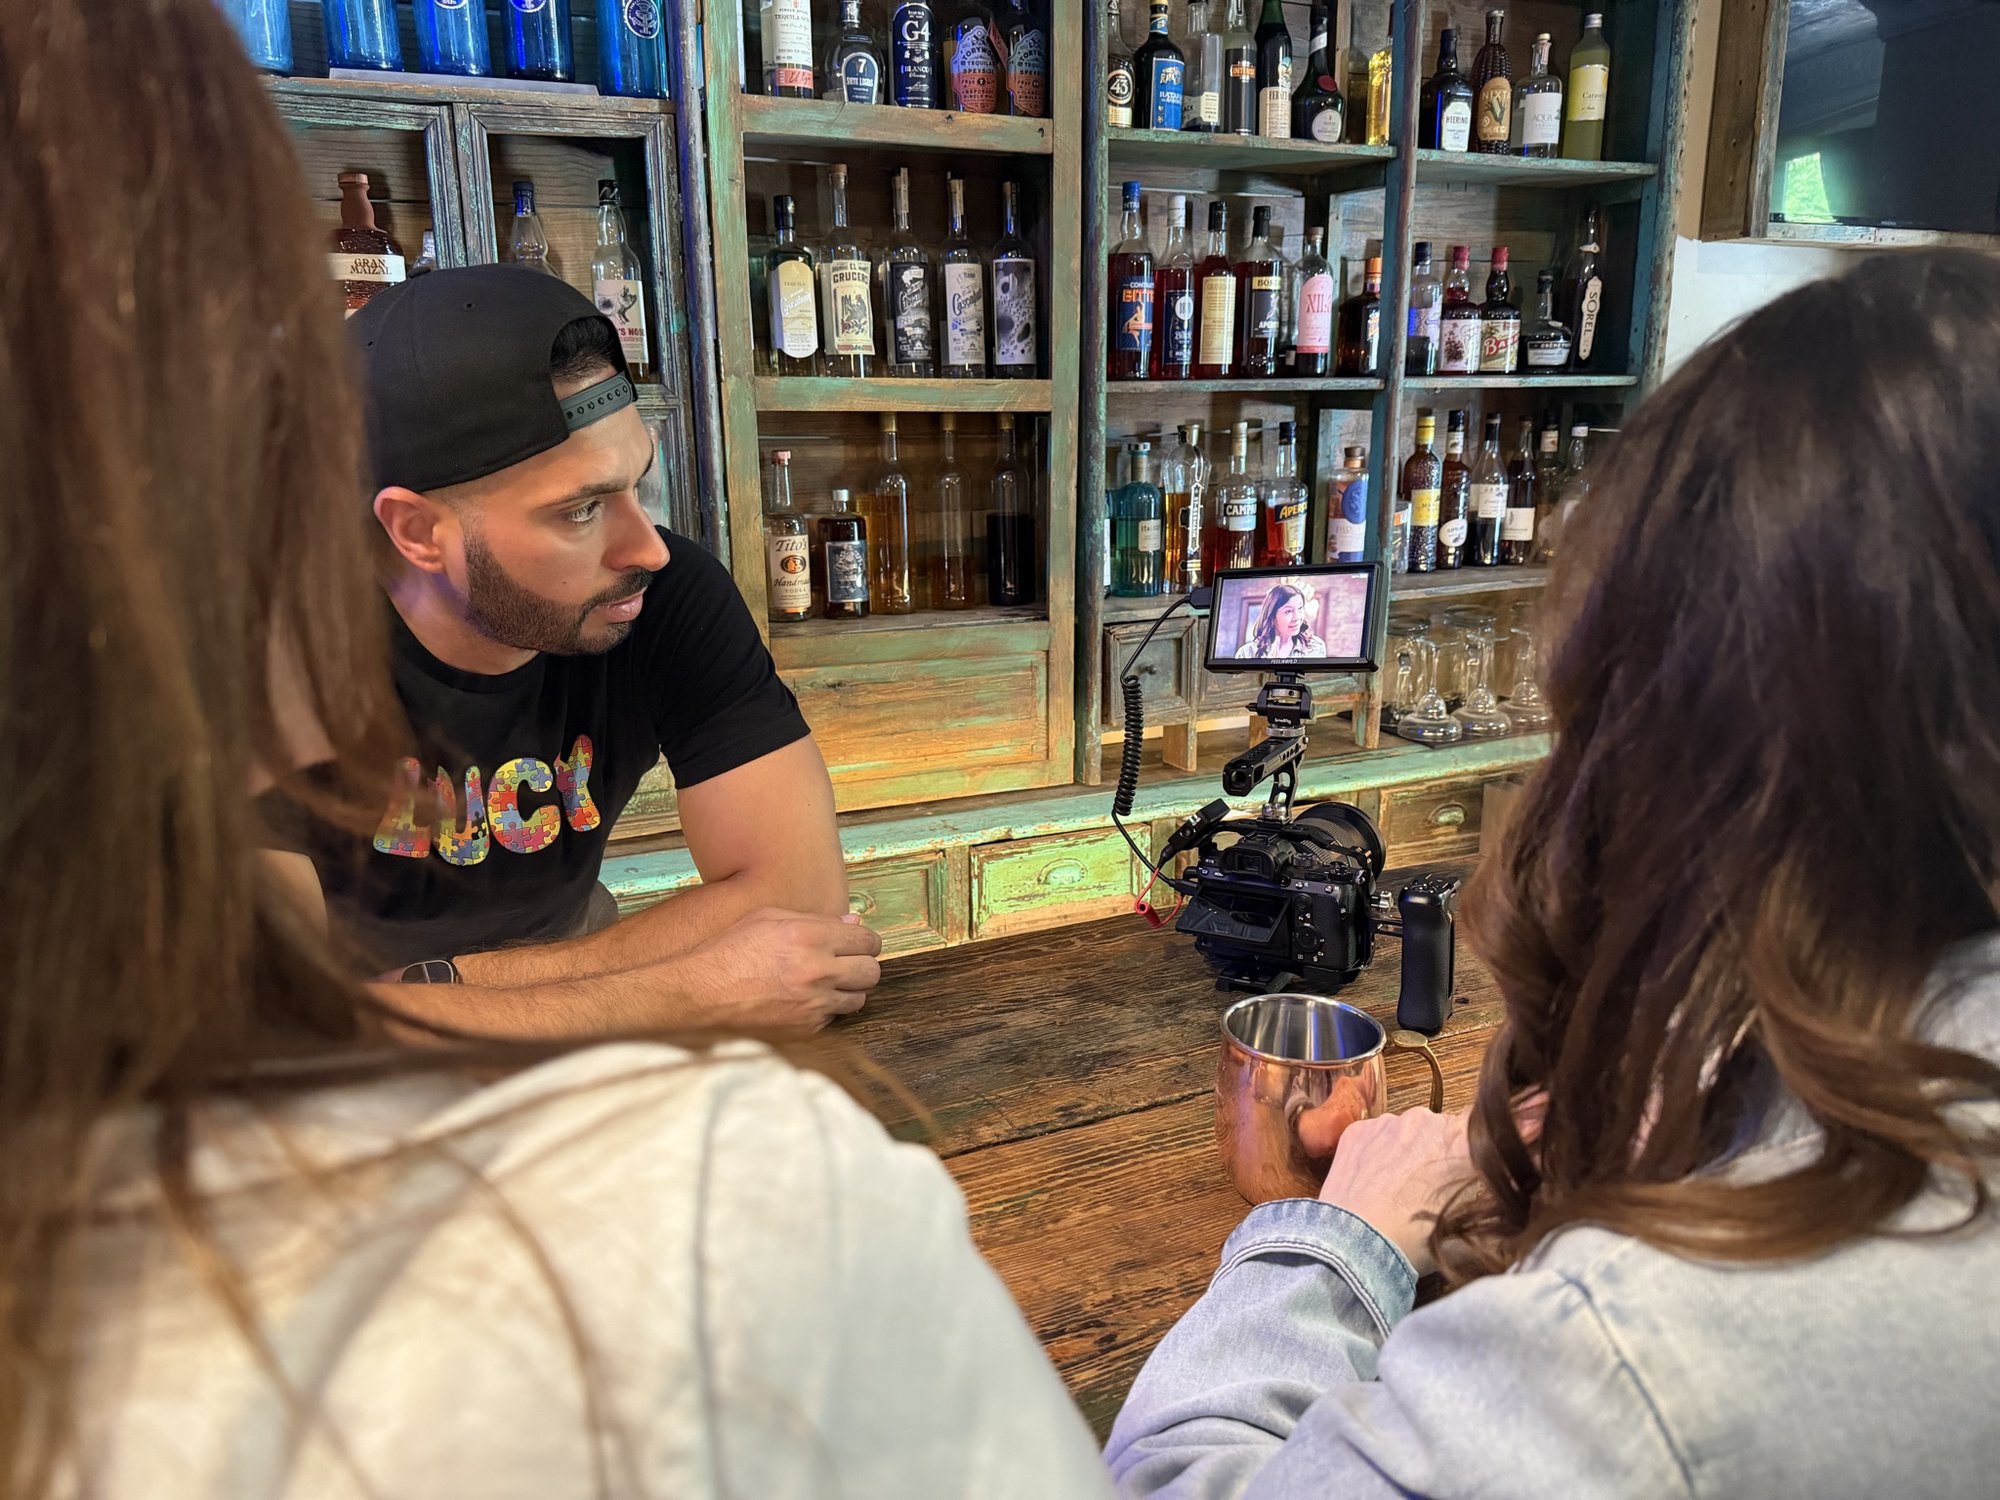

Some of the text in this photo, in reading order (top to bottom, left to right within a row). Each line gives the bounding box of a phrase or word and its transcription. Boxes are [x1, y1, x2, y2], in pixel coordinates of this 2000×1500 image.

[902, 20, 931, 41] G4
[858, 59, 867, 73] 7
[1110, 79, 1129, 95] 43
[1532, 113, 1553, 123] AQUA
[350, 265, 392, 275] MAIZAL
[354, 258, 386, 269] GRAN
[833, 271, 868, 285] CRUCERO
[1583, 291, 1598, 336] SOREL
[1226, 504, 1257, 516] CAMPA
[1279, 501, 1308, 519] APERO
[776, 538, 807, 552] Tito's
